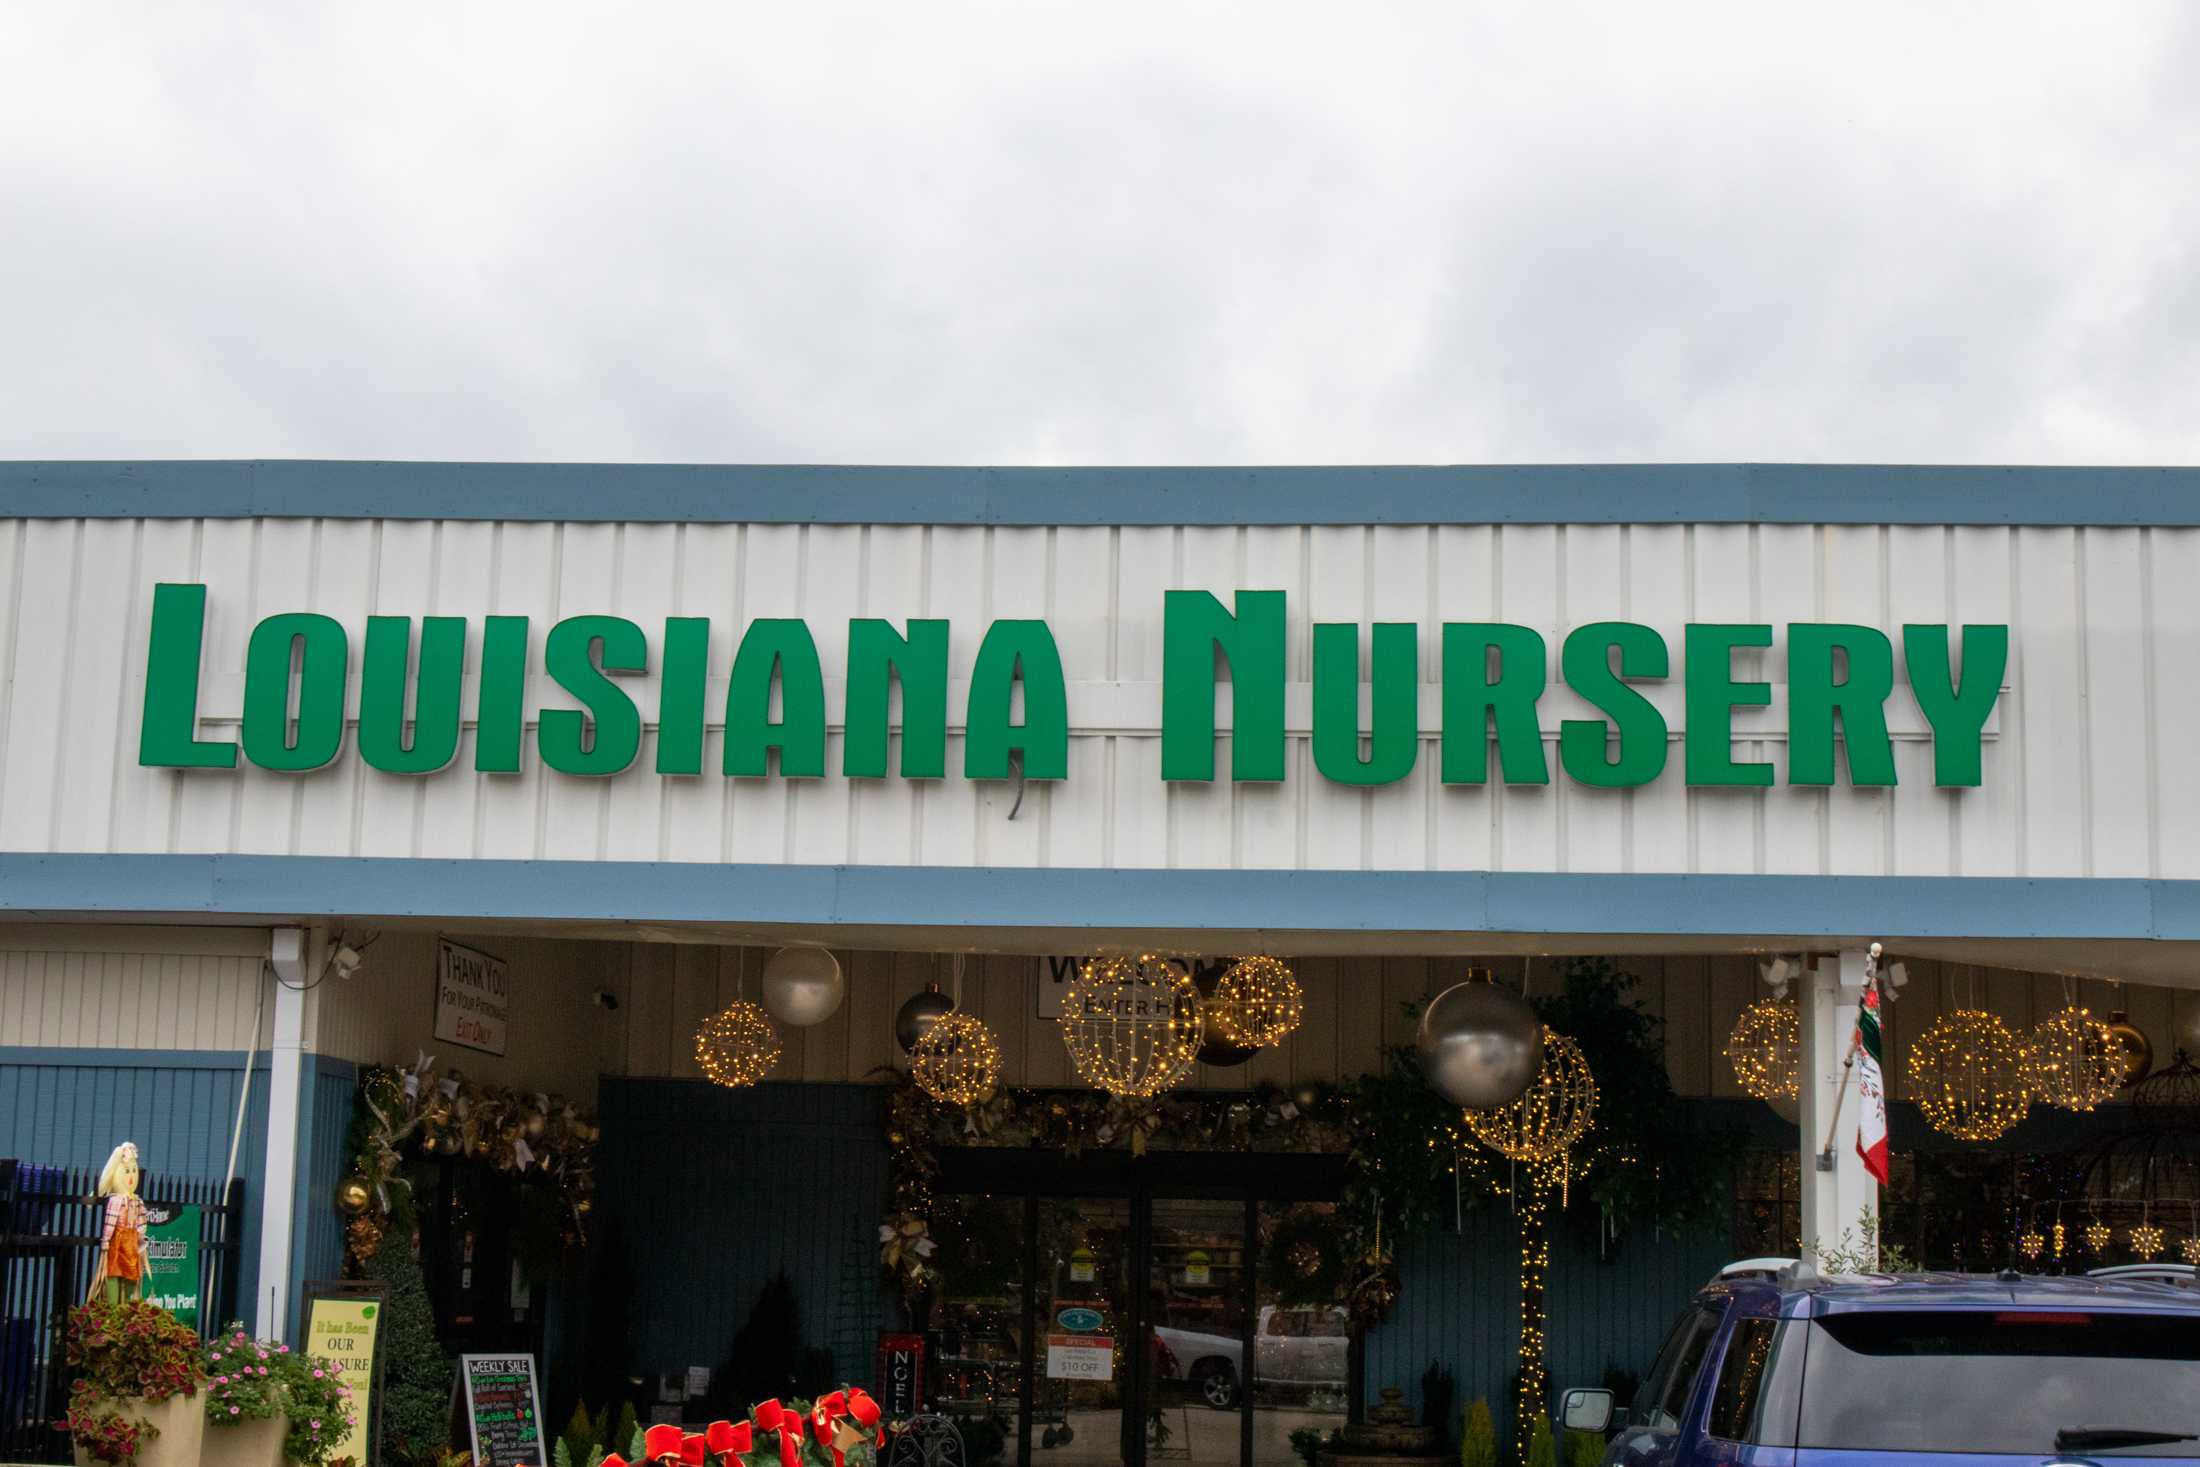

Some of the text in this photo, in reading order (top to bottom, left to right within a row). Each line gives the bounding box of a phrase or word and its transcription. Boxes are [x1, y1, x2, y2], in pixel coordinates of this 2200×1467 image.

[138, 582, 2009, 788] LOUISIANA NURSERY
[442, 945, 506, 998] THANK YOU
[441, 986, 457, 1007] FOR
[1084, 996, 1149, 1016] ENTER
[145, 1235, 188, 1259] timulator
[327, 1337, 354, 1351] OUR
[469, 1360, 529, 1374] WEEKLY SALE
[1080, 1361, 1099, 1373] OFF
[894, 1350, 909, 1414] NOEL
